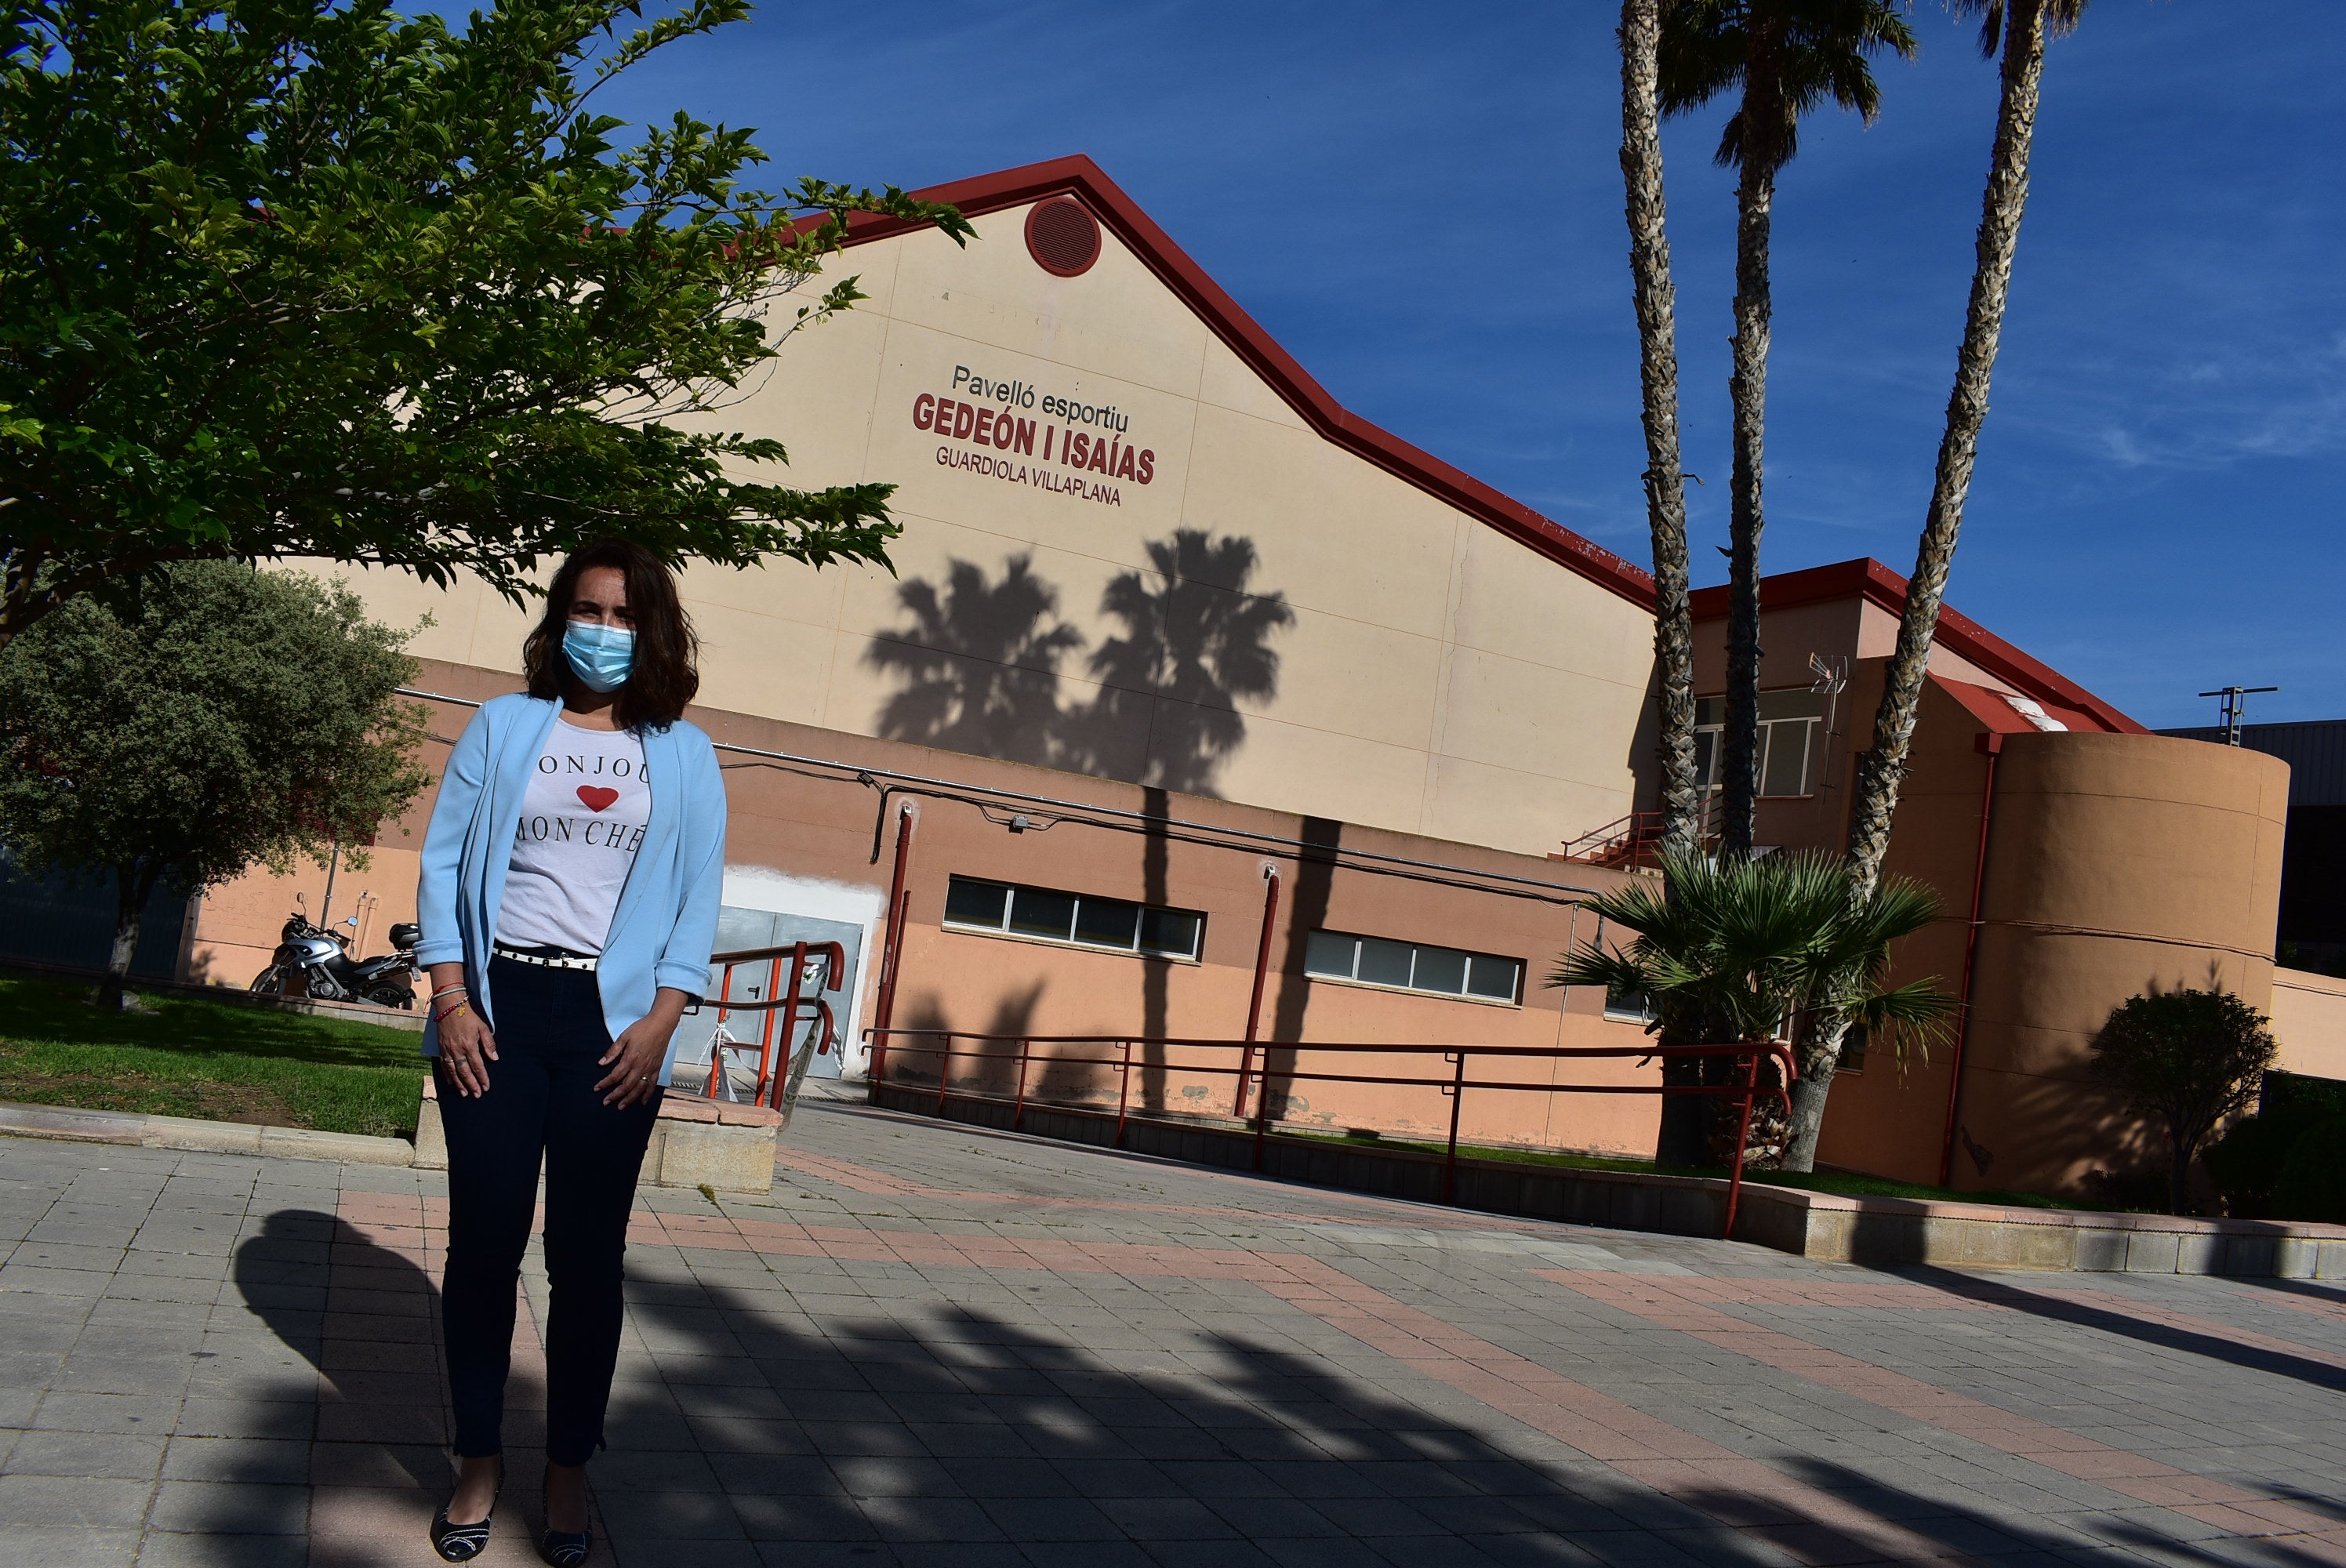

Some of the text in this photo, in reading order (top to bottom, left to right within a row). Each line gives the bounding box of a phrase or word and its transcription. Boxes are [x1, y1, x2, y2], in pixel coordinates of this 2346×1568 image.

[952, 365, 1128, 433] Pavelló esportiu
[913, 393, 1156, 485] GEDEÓN I ISAÍAS
[936, 446, 1120, 506] GUARDIOLA VILLAPLANA
